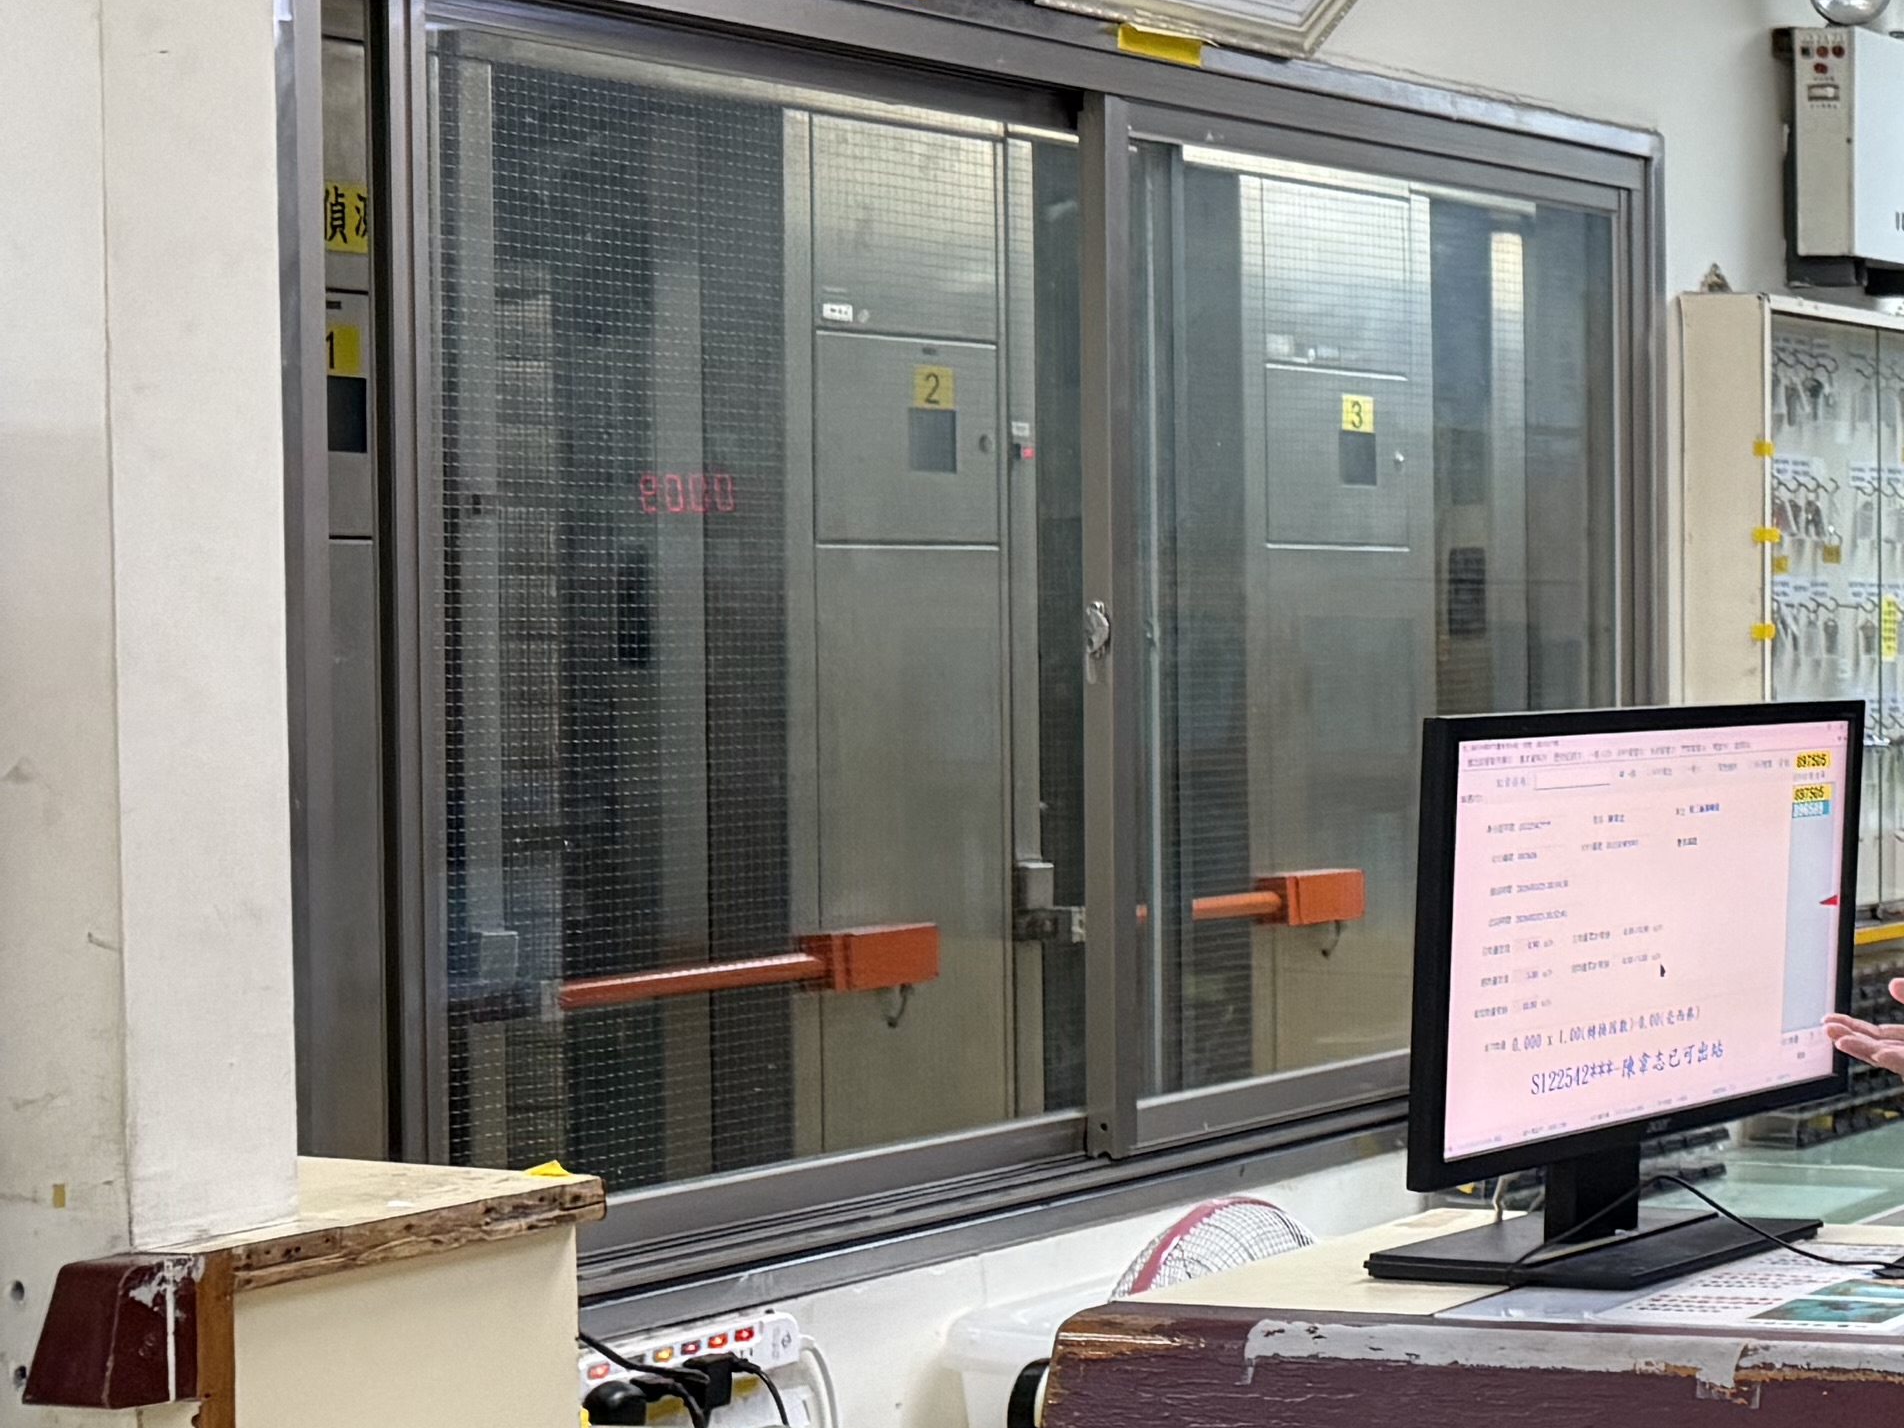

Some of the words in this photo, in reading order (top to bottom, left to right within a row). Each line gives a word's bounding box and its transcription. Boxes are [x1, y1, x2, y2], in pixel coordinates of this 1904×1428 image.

[326, 331, 335, 369] 1
[924, 373, 941, 405] 2
[1350, 399, 1364, 429] 3
